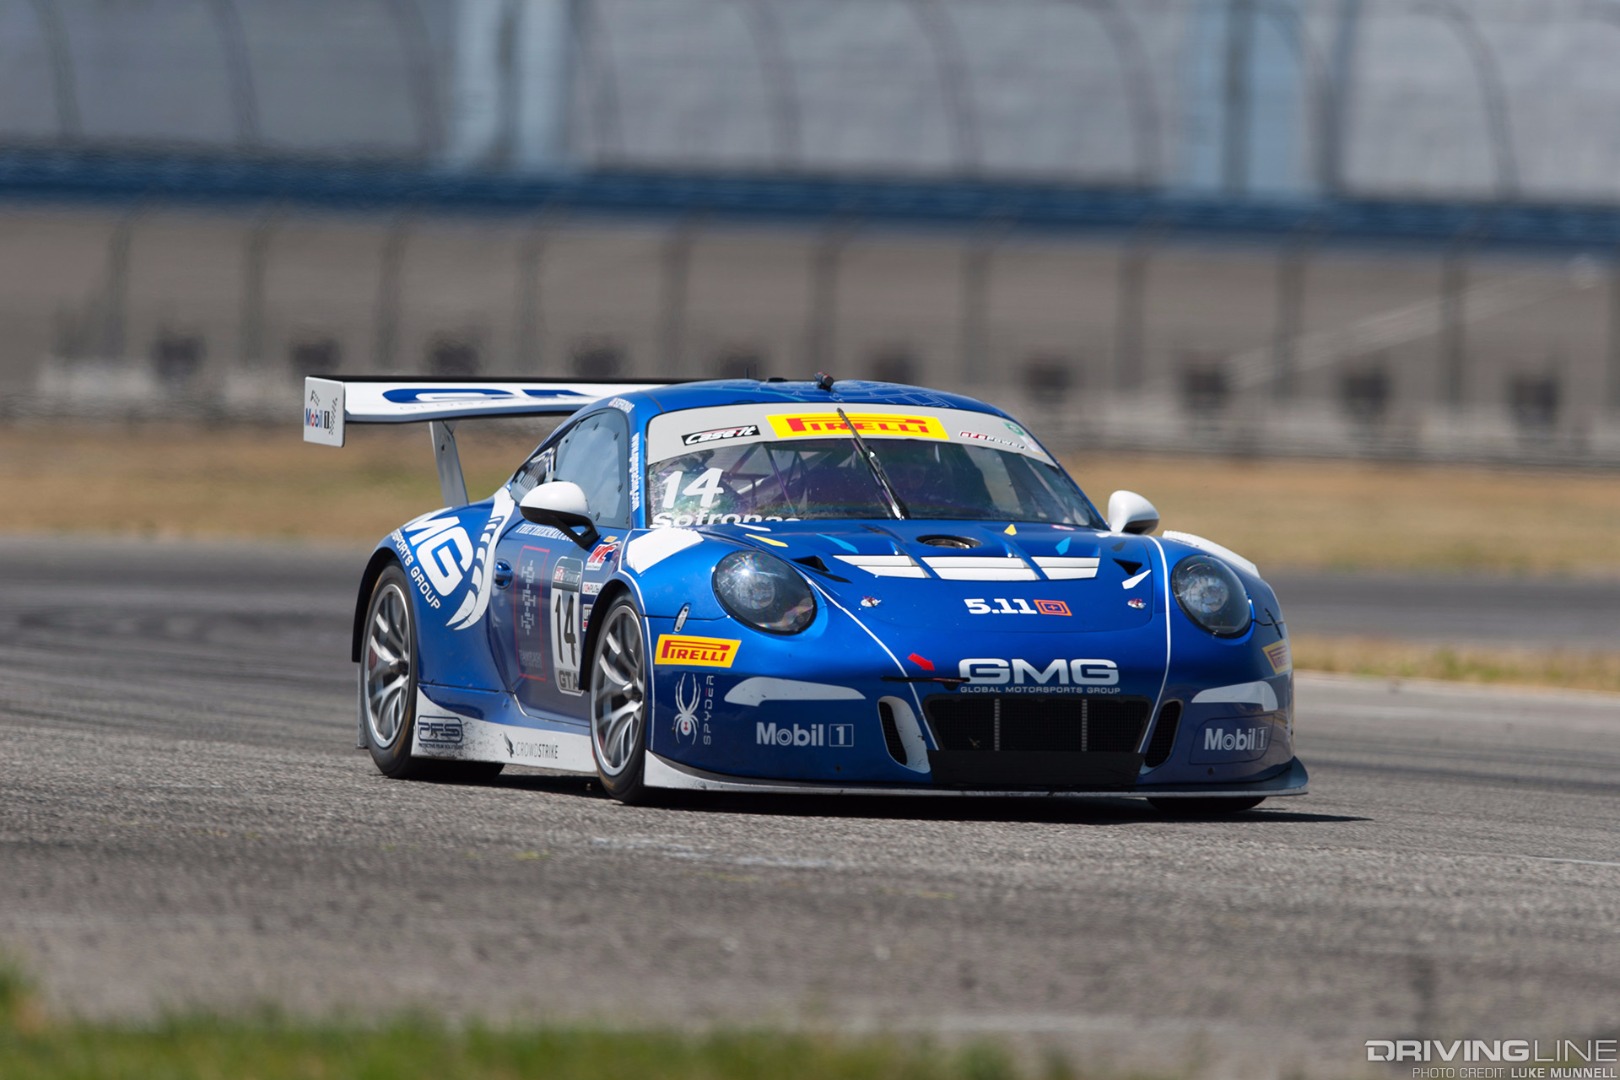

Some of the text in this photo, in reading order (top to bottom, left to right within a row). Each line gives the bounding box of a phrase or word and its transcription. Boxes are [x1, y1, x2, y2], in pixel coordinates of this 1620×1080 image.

[305, 408, 323, 428] Mobil
[786, 418, 929, 433] PIRELLI
[662, 467, 724, 508] 14
[410, 566, 441, 609] GROUP
[963, 599, 1038, 614] 5.11
[555, 594, 577, 667] 14
[661, 640, 731, 662] PIRELLI
[958, 658, 1120, 685] GMG
[703, 675, 715, 745] SPYDER
[756, 721, 824, 746] Mobil
[1204, 728, 1256, 750] Mobil
[515, 741, 558, 759] CROWDSTRIKE
